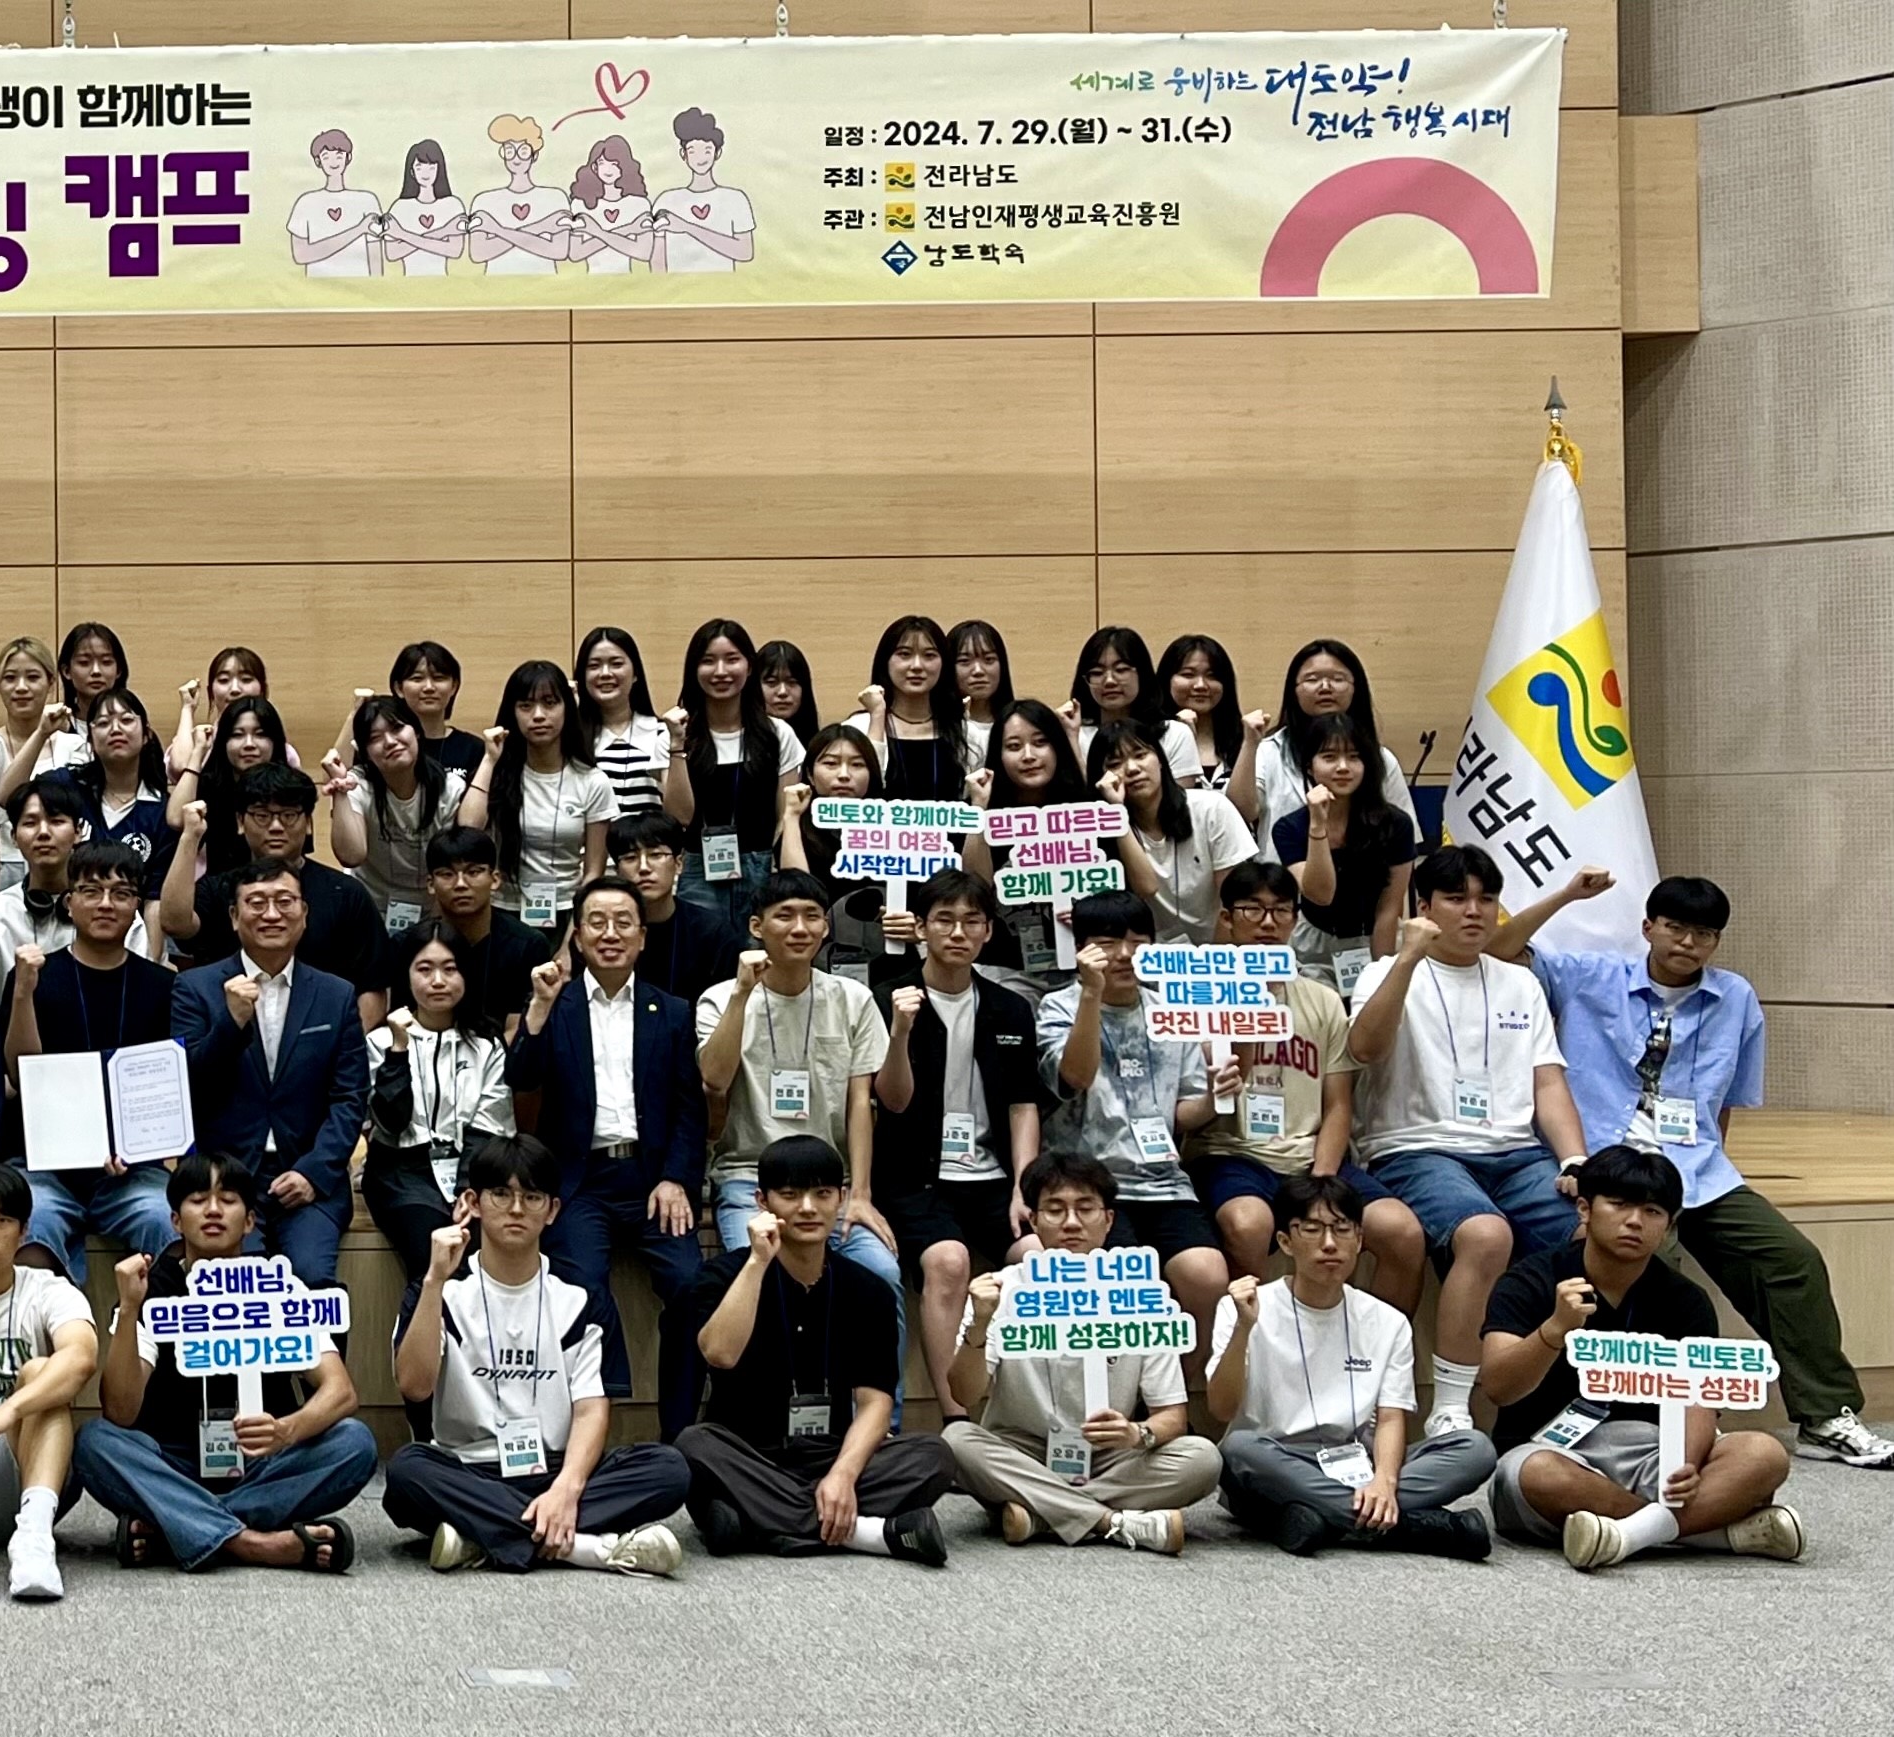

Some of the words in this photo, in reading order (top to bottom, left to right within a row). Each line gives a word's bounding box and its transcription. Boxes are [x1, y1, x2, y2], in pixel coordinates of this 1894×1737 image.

[78, 83, 252, 128] 함께하는
[824, 127, 864, 146] 일정
[884, 121, 968, 146] 2024.
[978, 121, 1002, 145] 7.
[1012, 118, 1107, 145] 29.(월)
[1141, 116, 1232, 144] 31.(수)
[1307, 107, 1376, 141] 전남
[1381, 102, 1447, 138] 행복
[824, 168, 863, 188] 주최
[924, 165, 1018, 187] 전라남도
[65, 150, 251, 278] 캠프
[824, 209, 864, 230] 주관
[924, 202, 1181, 229] 전남인재평생교육진흥원
[818, 804, 884, 825] 멘토와
[891, 805, 979, 828] 함께하는
[1452, 716, 1573, 889] 라남도
[989, 812, 1040, 839] 믿고
[1047, 809, 1122, 834] 따르는
[847, 829, 890, 850] 꿈의
[898, 832, 948, 853] 여정,
[1017, 839, 1099, 867] 선배님,
[1001, 871, 1052, 898] 함께
[1061, 866, 1118, 893] 가요!
[1140, 951, 1236, 975] 선배님만
[1244, 952, 1291, 975] 믿고
[1167, 981, 1269, 1007] 따를게요,
[1152, 1012, 1200, 1035] 멋진
[1208, 1012, 1287, 1035] 내일로!
[194, 1264, 293, 1296] 선배님,
[1031, 1257, 1086, 1283] 나는
[1097, 1254, 1152, 1281] 너의
[150, 1302, 271, 1334] 믿음으로
[281, 1297, 342, 1327] 함께
[1014, 1289, 1100, 1317] 영원한
[1108, 1288, 1173, 1316] 멘토,
[1000, 1323, 1056, 1351] 함께
[1066, 1320, 1189, 1350] 성장하자!
[183, 1335, 313, 1369] 걸어가요!
[498, 1348, 536, 1367] 1950
[1344, 1355, 1372, 1368] Jeep
[1573, 1336, 1677, 1367] 함께하는
[1687, 1344, 1772, 1375] 멘토링,
[471, 1366, 558, 1382] DYNAFIT
[1586, 1368, 1690, 1399] 함께하는
[1699, 1376, 1759, 1402] 성장!
